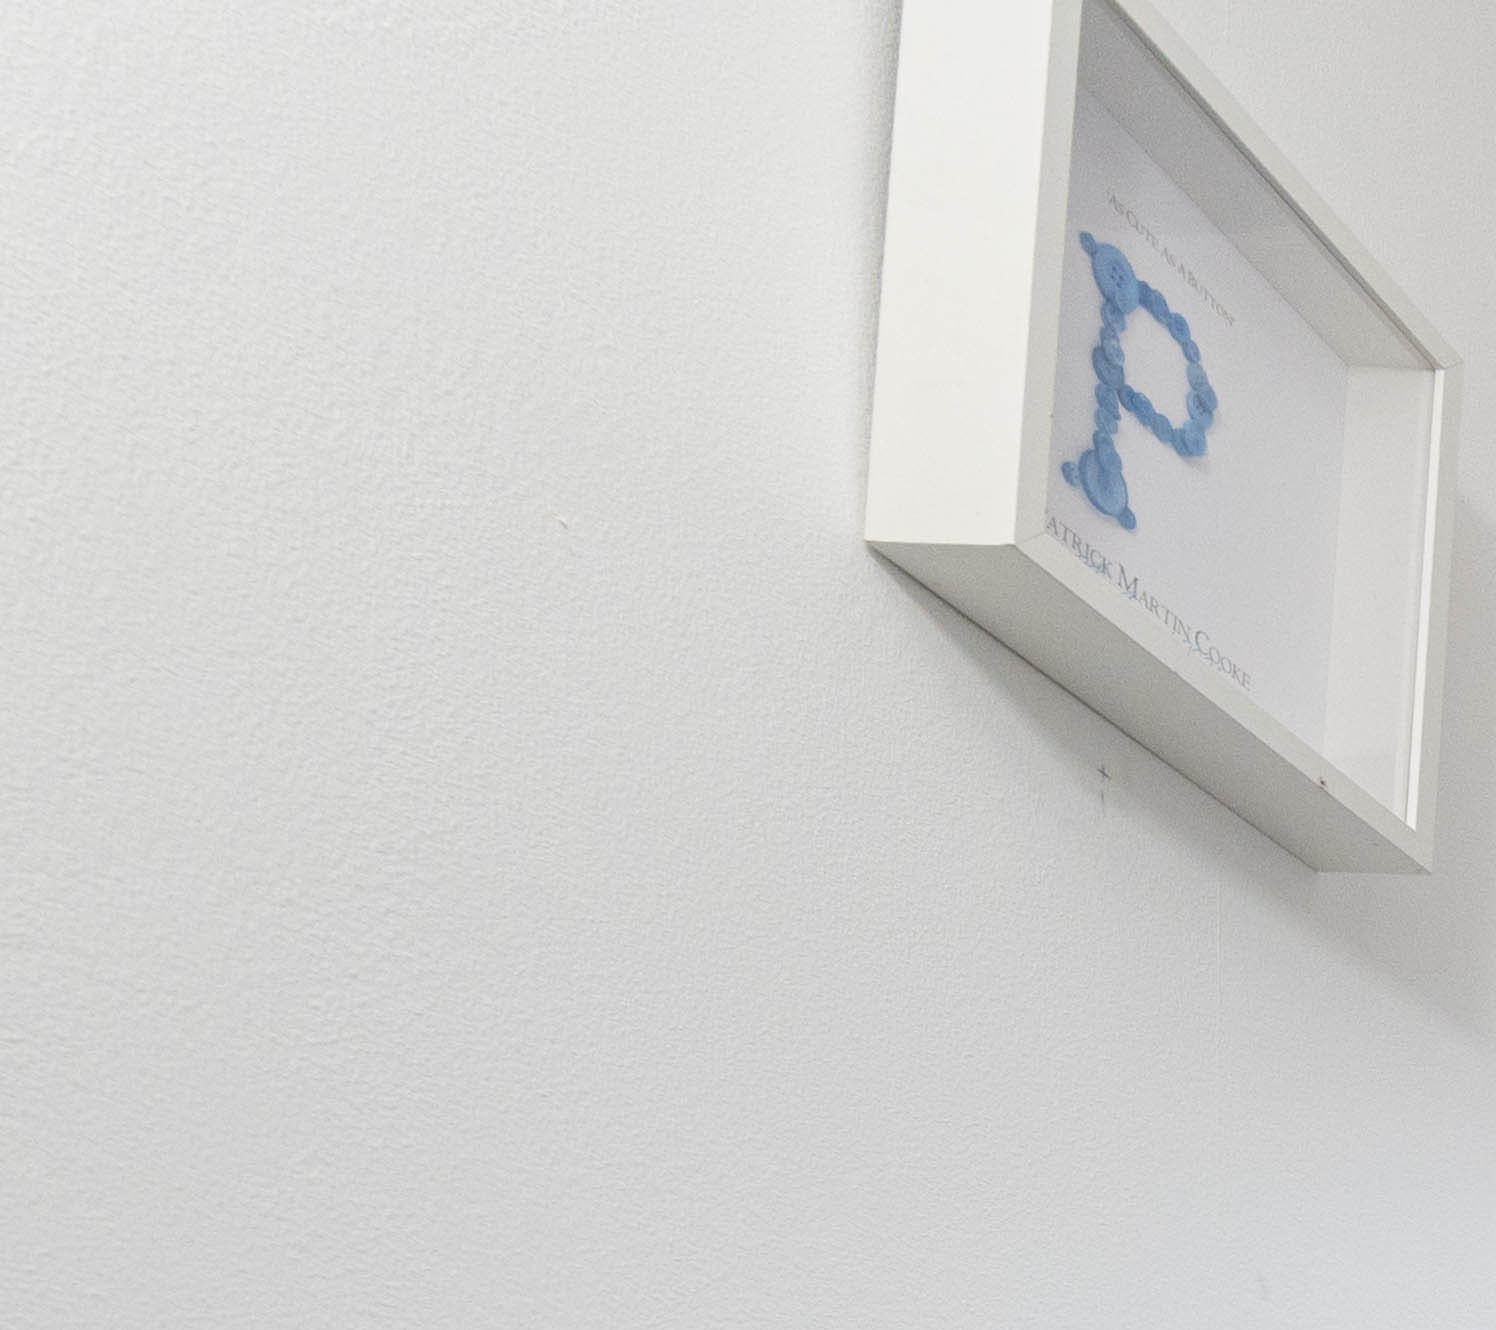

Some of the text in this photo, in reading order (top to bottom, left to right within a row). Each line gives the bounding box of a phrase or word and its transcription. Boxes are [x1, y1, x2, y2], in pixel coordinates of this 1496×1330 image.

[1045, 515, 1252, 691] ATRICK MARTIN COOKE
